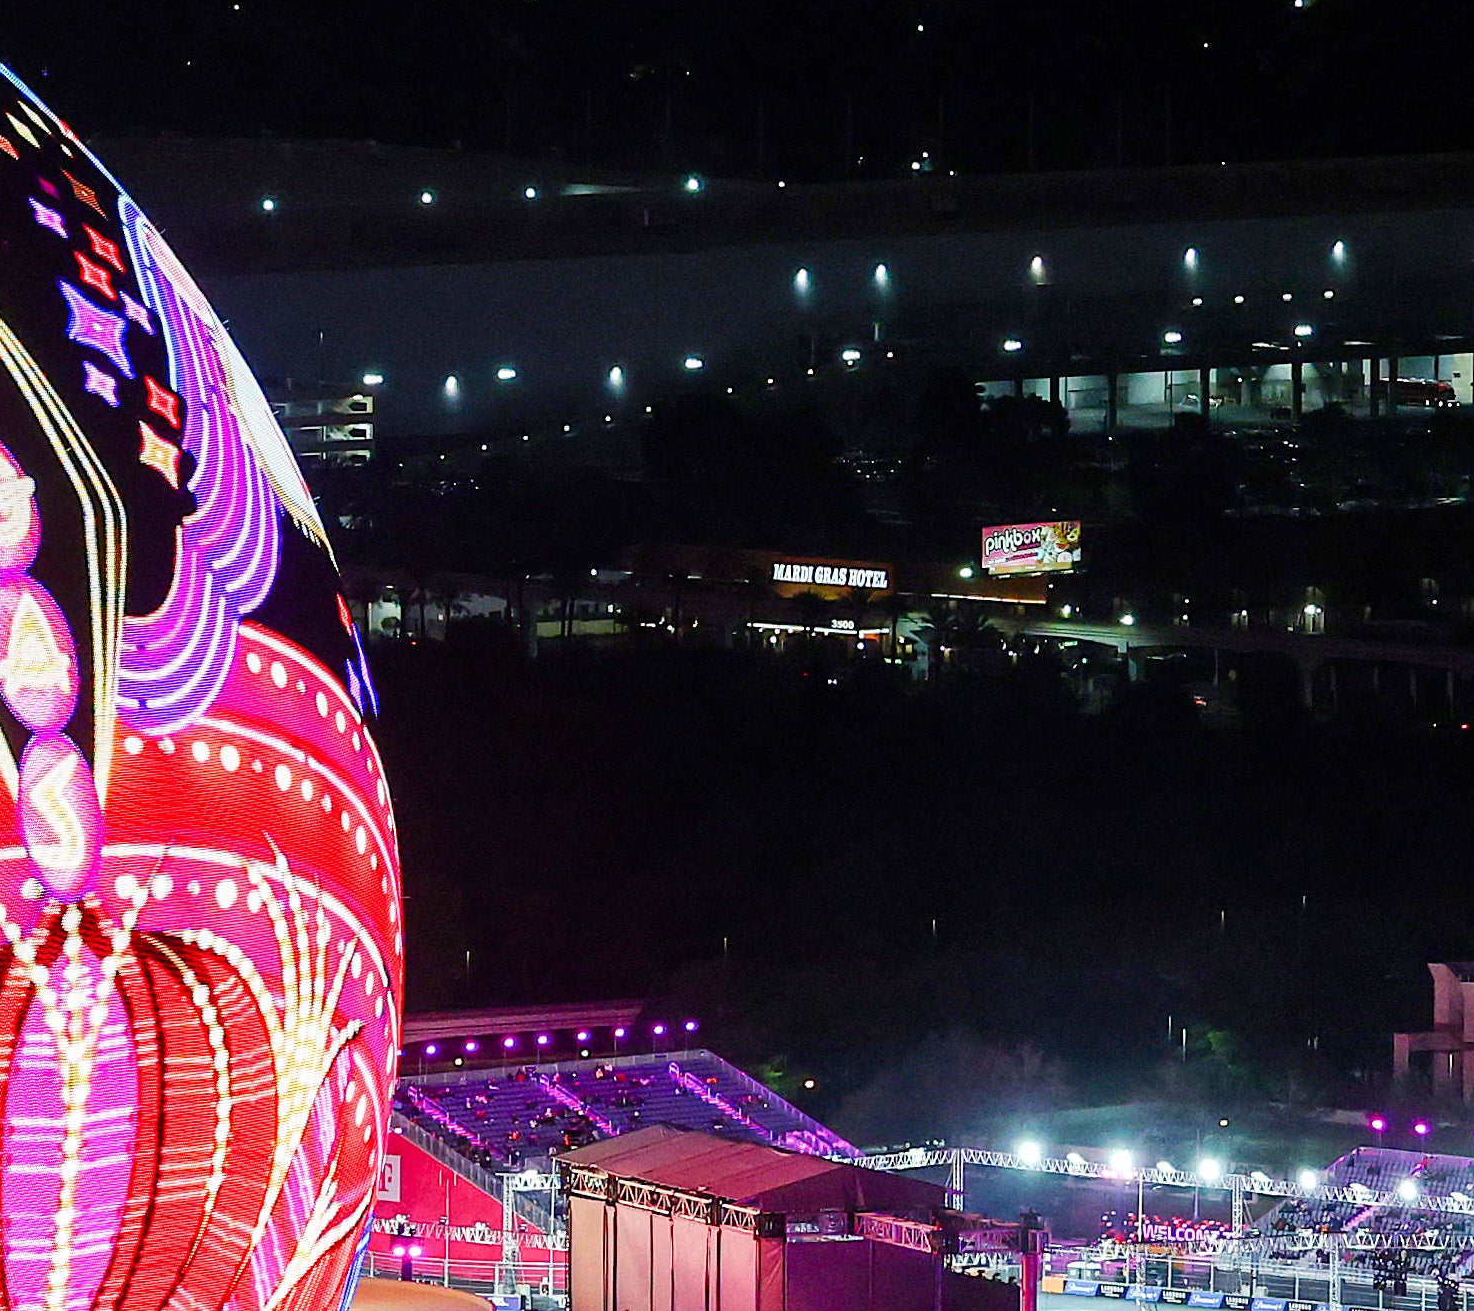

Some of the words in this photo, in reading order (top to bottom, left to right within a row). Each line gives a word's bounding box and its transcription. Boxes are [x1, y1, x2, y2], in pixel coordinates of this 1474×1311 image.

[985, 526, 1042, 557] pinkbox
[773, 563, 813, 583] MARDI
[814, 566, 847, 585] GRAS
[848, 569, 888, 589] HOTEL
[831, 619, 854, 630] 3500
[1143, 1224, 1218, 1242] WELCOM
